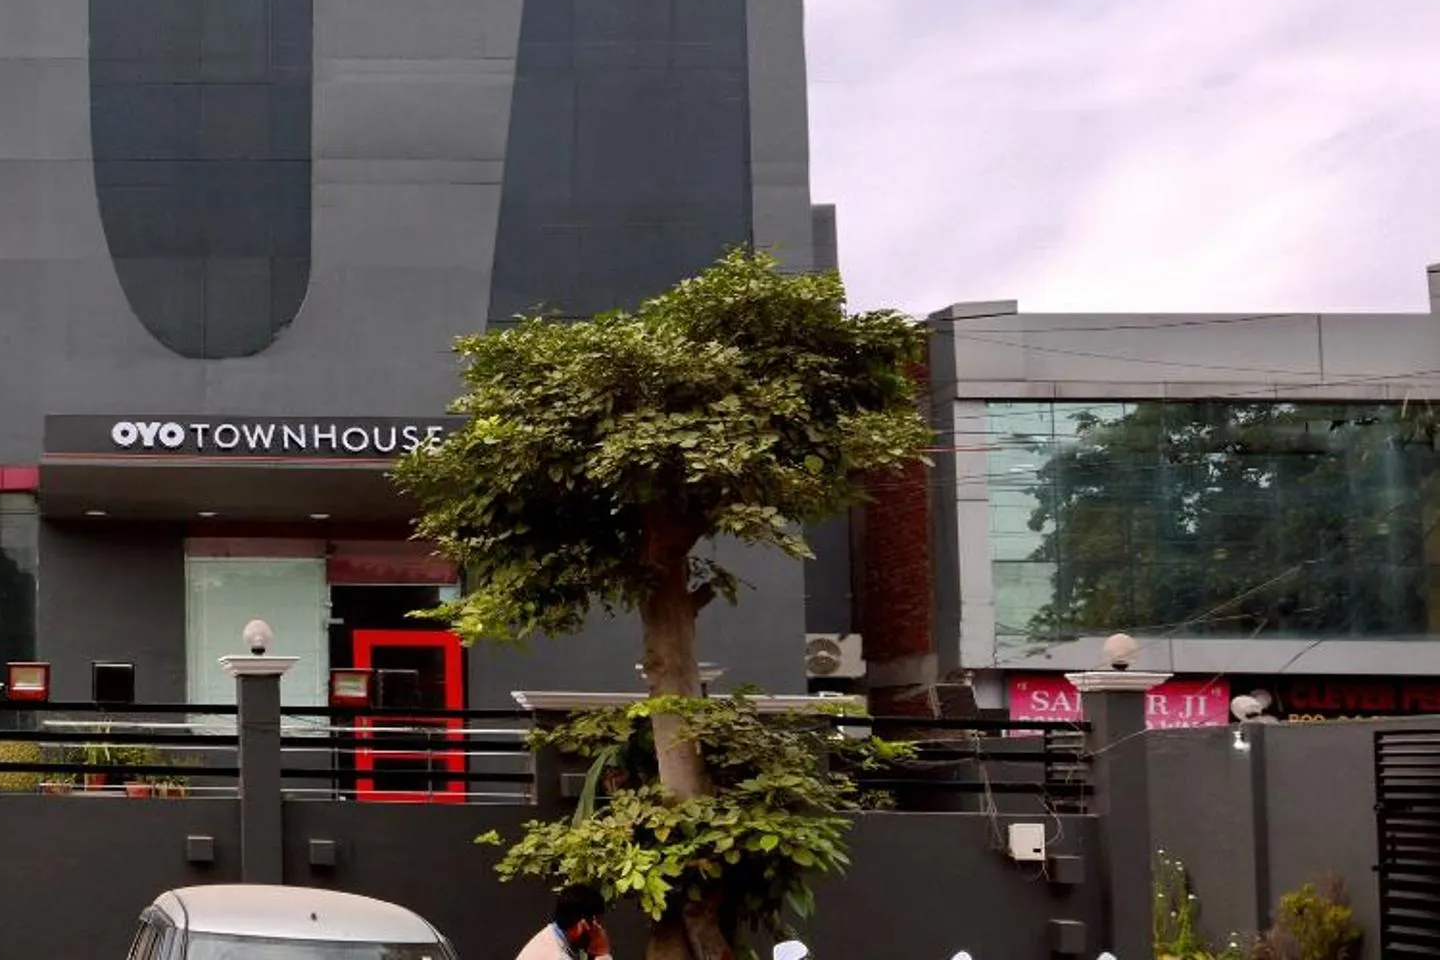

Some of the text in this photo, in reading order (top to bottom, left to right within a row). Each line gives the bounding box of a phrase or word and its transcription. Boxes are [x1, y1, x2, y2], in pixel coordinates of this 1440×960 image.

[111, 421, 443, 453] OYO TOWNHOUSE
[1179, 695, 1209, 718] JI
